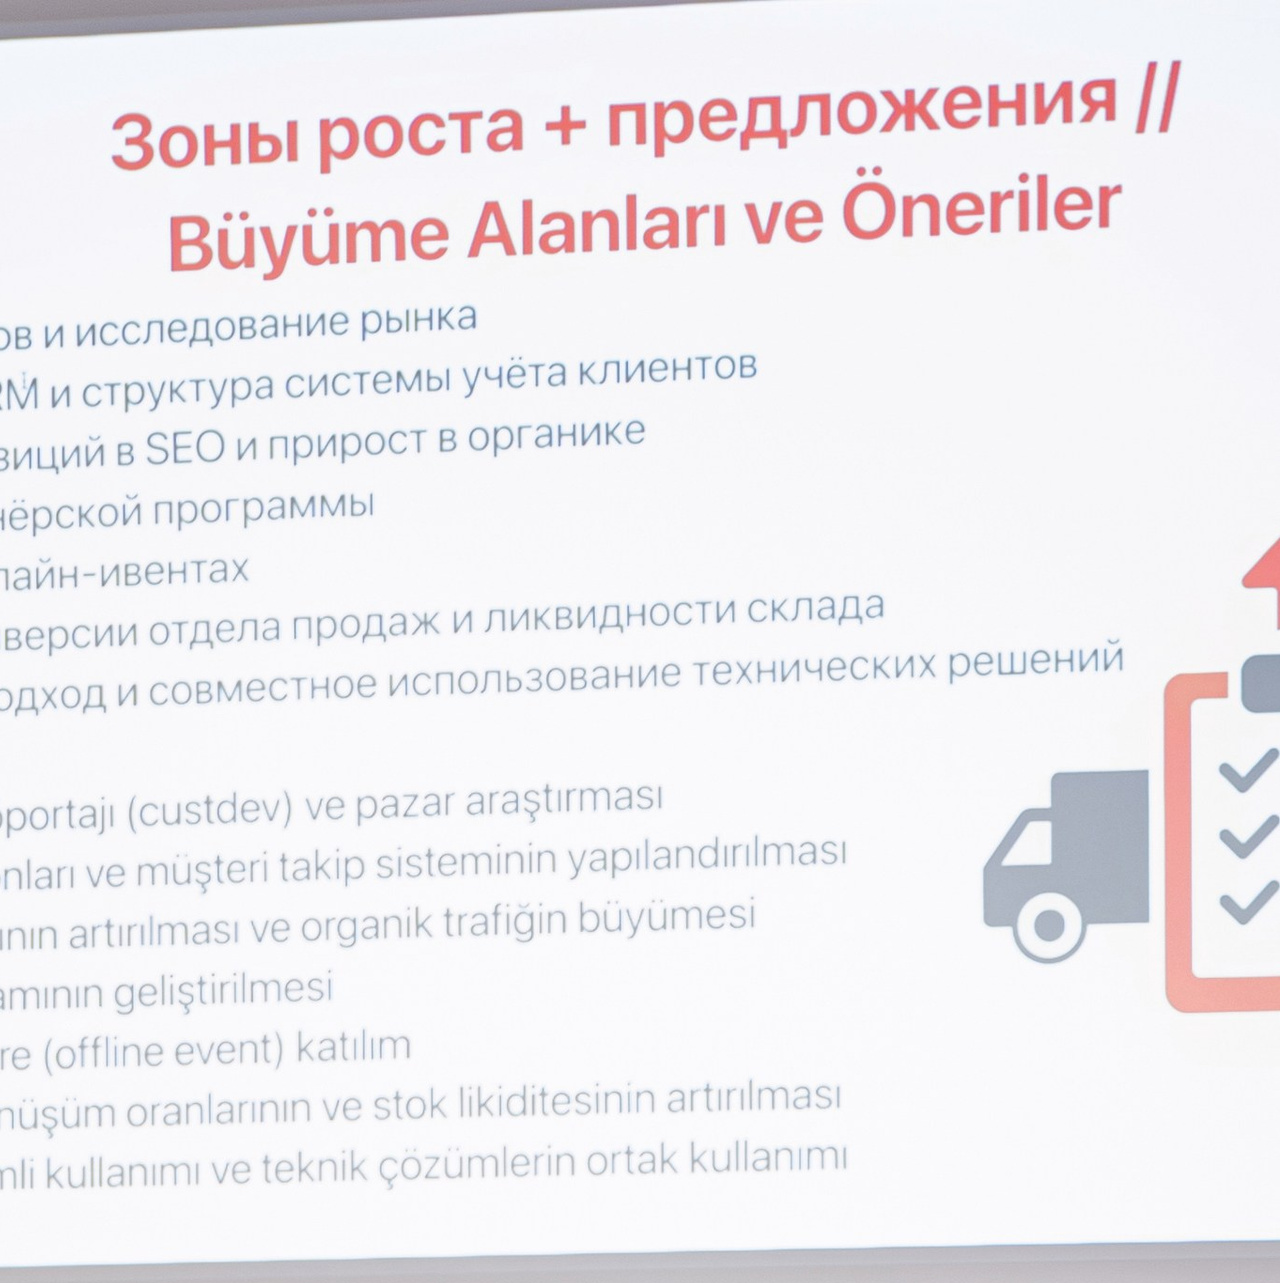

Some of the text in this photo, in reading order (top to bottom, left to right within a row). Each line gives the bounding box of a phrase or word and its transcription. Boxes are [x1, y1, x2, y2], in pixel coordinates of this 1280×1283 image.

[111, 60, 1182, 175] Зоны роста + предложения //
[170, 165, 1123, 281] Büyüme Alanları ve Öneriler
[44, 324, 64, 349] и
[76, 311, 350, 348] исследование
[361, 304, 477, 342] рынка
[51, 385, 71, 409] и
[82, 375, 274, 413] структура
[285, 367, 450, 399] системы
[462, 356, 567, 399] учёта
[579, 354, 758, 385] клиентов
[117, 442, 134, 466] в
[146, 429, 225, 465] SEO
[237, 437, 257, 461] и
[269, 429, 427, 466] прирост
[439, 428, 458, 453] в
[468, 419, 645, 458] органике
[154, 492, 373, 532] программы
[149, 617, 280, 650] отдела
[293, 612, 440, 647] продаж
[453, 610, 473, 634] и
[484, 600, 735, 634] ликвидности
[748, 594, 884, 626] склада
[118, 684, 138, 707] и
[150, 674, 377, 706] совместное
[389, 663, 681, 697] использование
[693, 654, 936, 686] технических
[949, 638, 1123, 685] решений
[129, 790, 292, 834] (custdev)
[305, 796, 345, 820] ve
[357, 792, 455, 827] pazar
[467, 784, 662, 823] araştırması
[86, 864, 125, 888] ve
[138, 851, 267, 894] müşteri
[279, 848, 365, 887] takip
[377, 842, 556, 879] sisteminin
[568, 834, 846, 880] yapılandırılması
[70, 915, 238, 949] artırılması
[250, 919, 290, 943] ve
[302, 906, 432, 948] organik
[443, 903, 566, 943] trafiğin
[580, 896, 754, 939] büyümesi
[114, 970, 331, 1015] geliştirilmesi
[44, 1036, 163, 1076] (offline
[175, 1032, 283, 1070] event)
[298, 1028, 410, 1062] katılım
[127, 1093, 310, 1127] oranlarının
[323, 1097, 362, 1121] ve
[374, 1087, 447, 1120] stok
[460, 1083, 655, 1117] likiditesinin
[667, 1078, 840, 1113] artırılması
[47, 1156, 199, 1189] kullanımı
[212, 1161, 251, 1184] ve
[262, 1150, 367, 1183] teknik
[379, 1145, 575, 1190] çözümlerin
[587, 1142, 677, 1176] ortak
[691, 1140, 847, 1173] kullanımı
